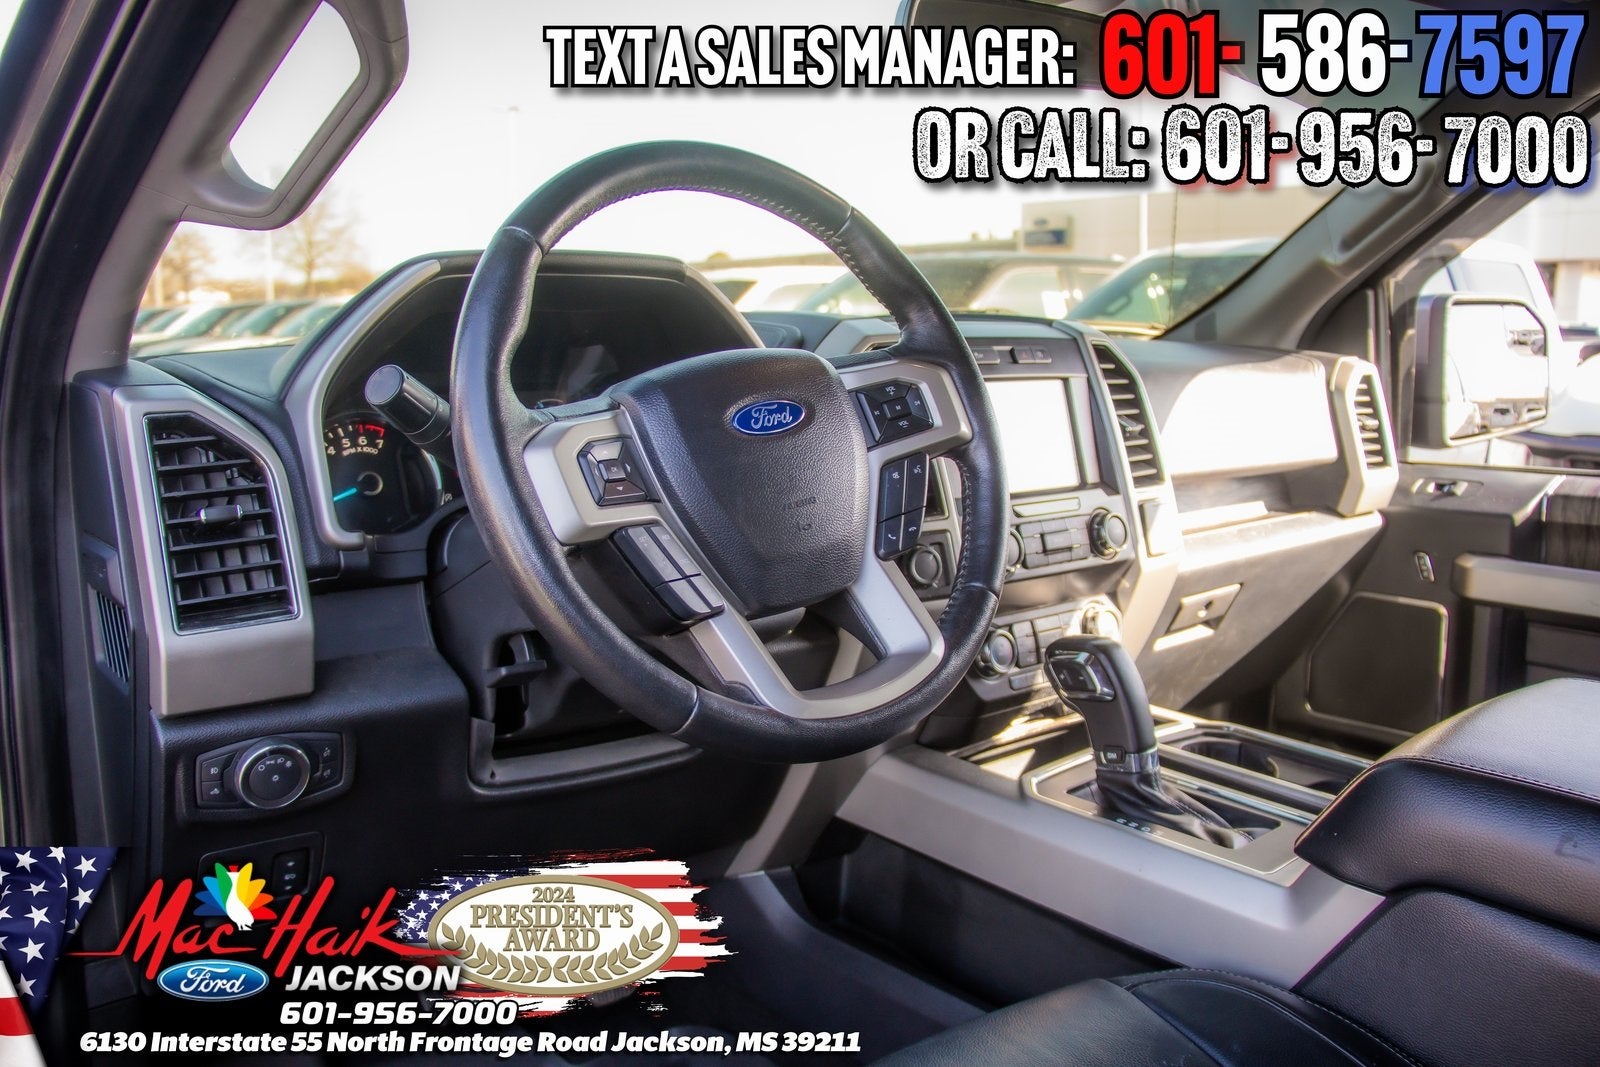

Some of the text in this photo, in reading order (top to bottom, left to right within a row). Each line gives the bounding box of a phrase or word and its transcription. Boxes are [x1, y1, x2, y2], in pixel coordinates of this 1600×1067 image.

[751, 404, 793, 430] Ford
[342, 439, 350, 447] 5
[358, 436, 367, 445] 6
[376, 440, 384, 448] 7
